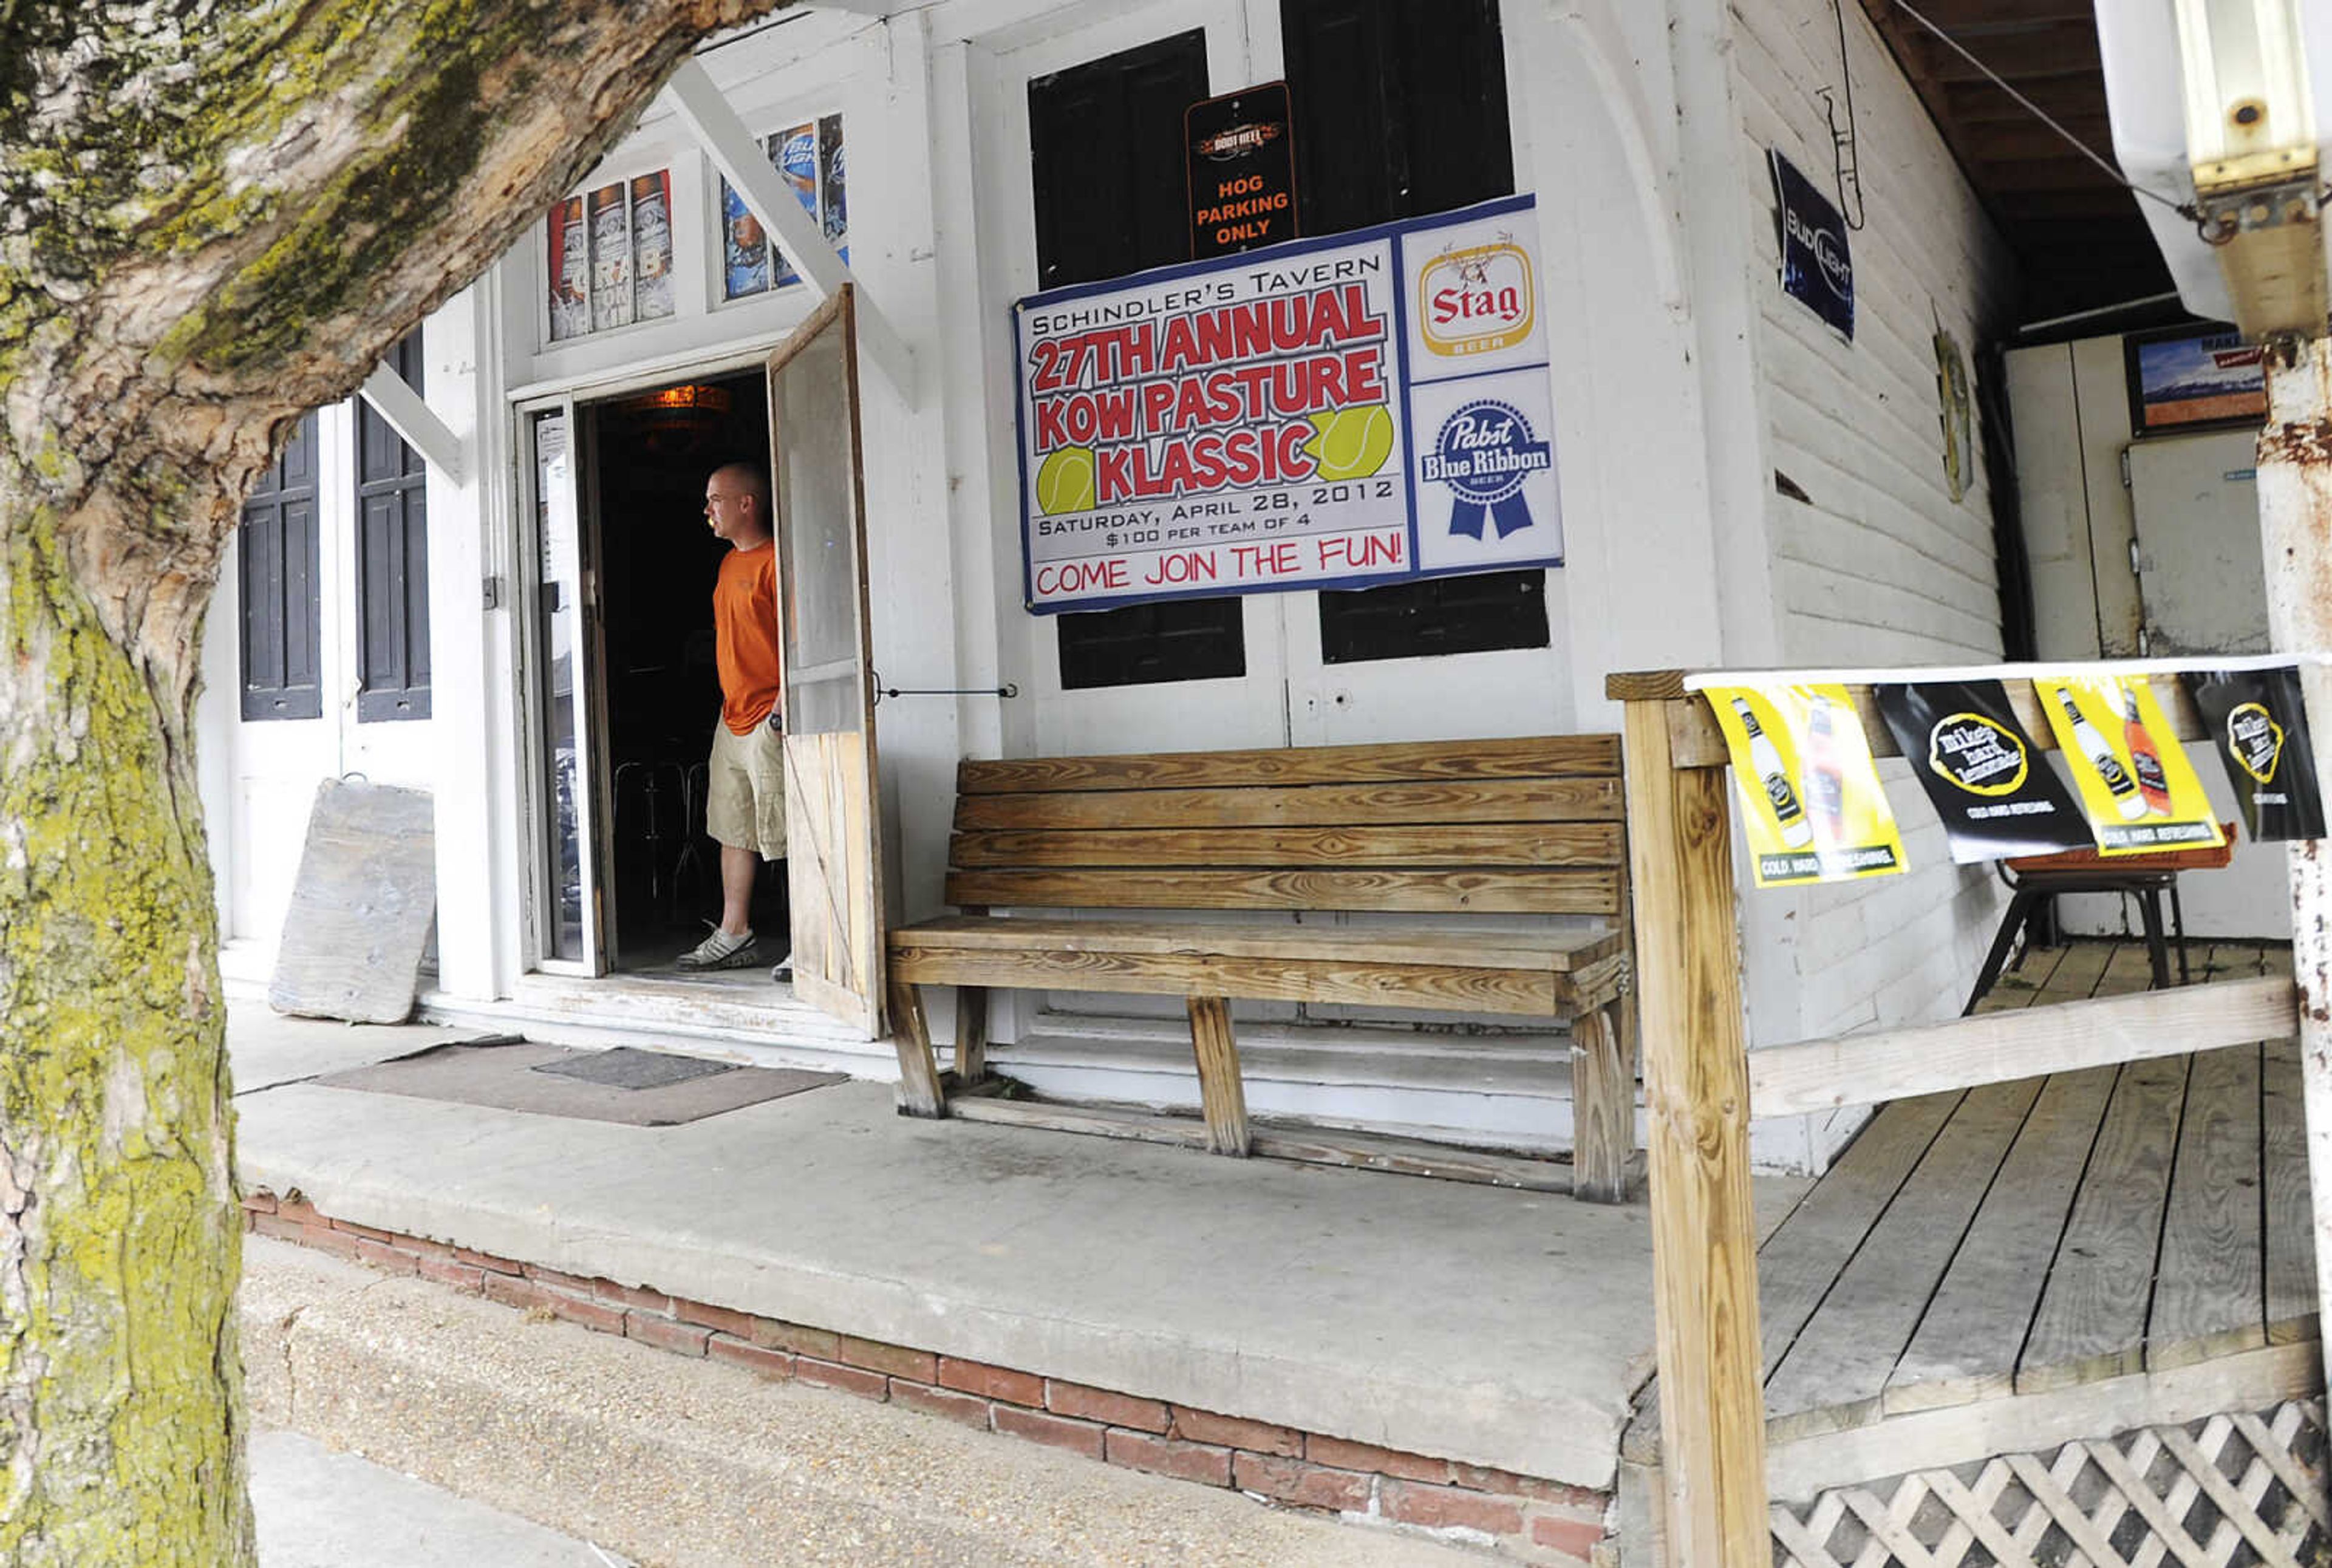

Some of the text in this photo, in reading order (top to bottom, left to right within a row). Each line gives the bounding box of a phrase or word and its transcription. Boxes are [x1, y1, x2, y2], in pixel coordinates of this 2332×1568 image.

[1218, 175, 1263, 199] HOG
[1198, 192, 1288, 227] PARKING
[1216, 218, 1270, 244] ONLY
[1787, 206, 1815, 250] BUD
[1818, 237, 1850, 285] LIGHT
[1032, 254, 1380, 335] SCHINDLER'S TAVERN
[1433, 286, 1521, 324] Stag
[1032, 284, 1383, 394] 27TH ANNUAL
[1036, 348, 1383, 451] KOW PASTURE
[1449, 416, 1515, 451] Pabst
[1096, 423, 1314, 502] KLASSIC
[1424, 447, 1548, 480] Blue Ribbon
[1039, 480, 1393, 536] SATURDAY, APRIL 28, 2012
[1106, 514, 1311, 548] $100 PER TEAM OF 4
[1037, 532, 1403, 595] COME JOIN THE FUN!
